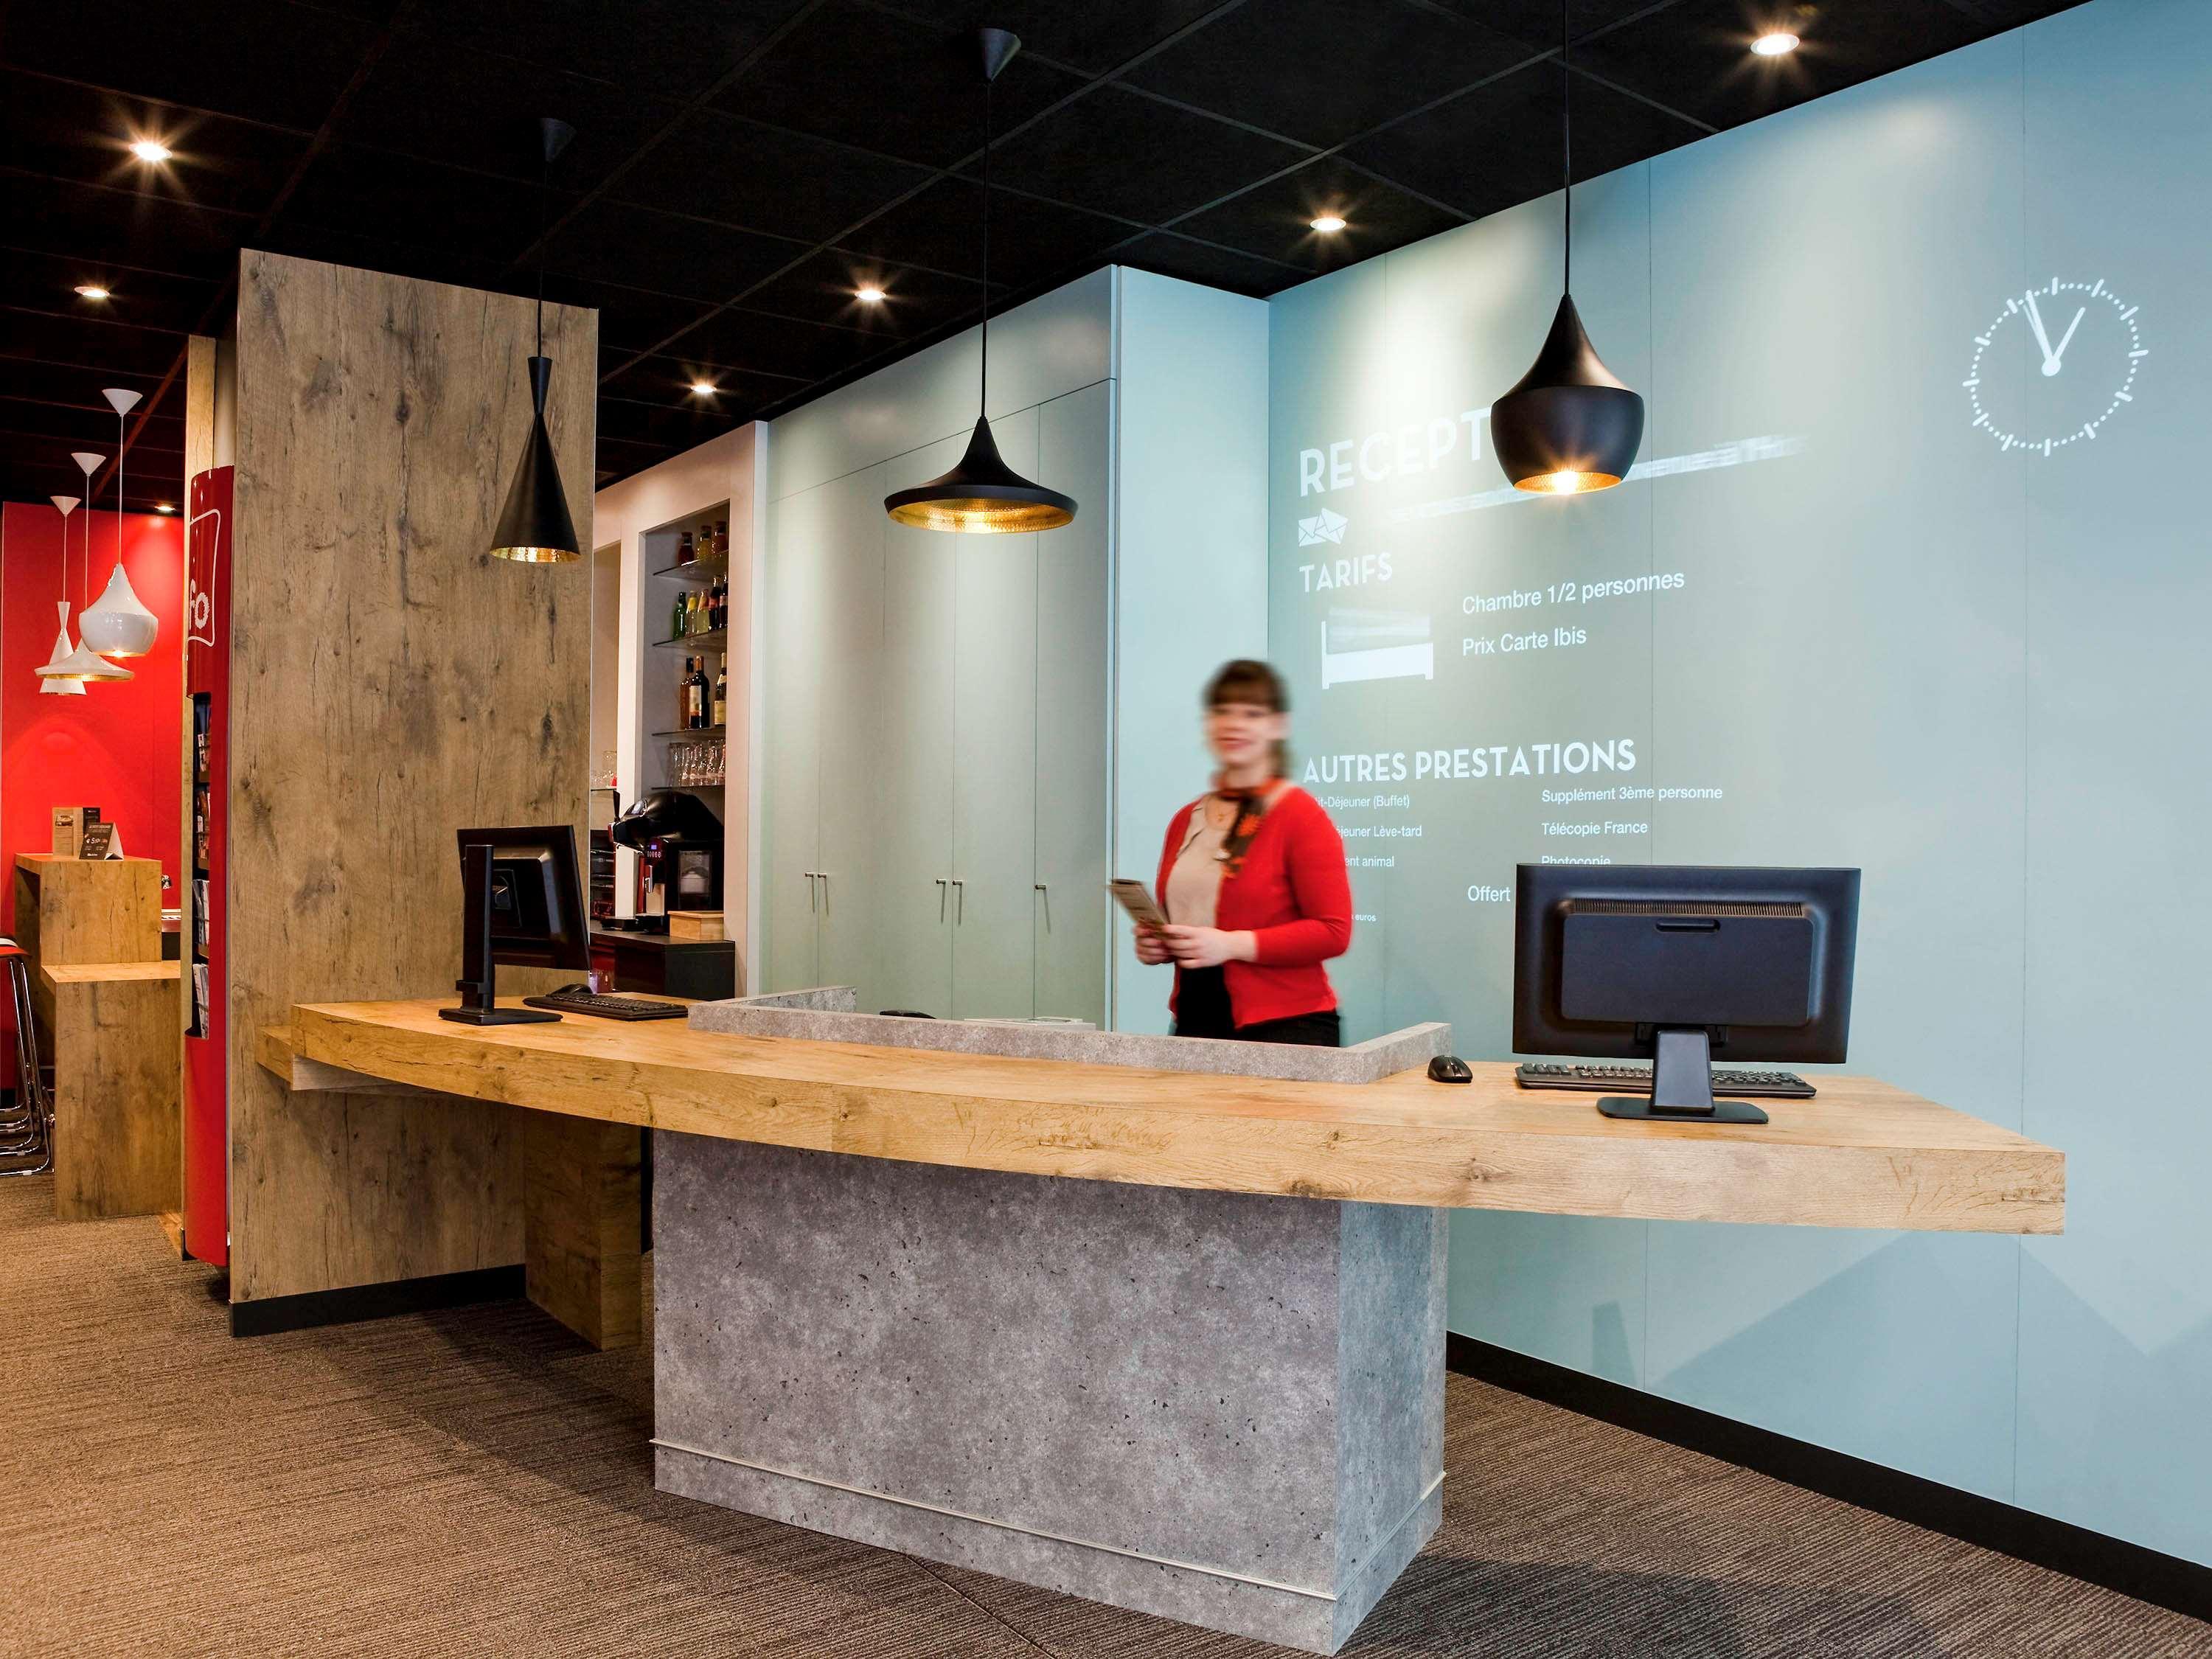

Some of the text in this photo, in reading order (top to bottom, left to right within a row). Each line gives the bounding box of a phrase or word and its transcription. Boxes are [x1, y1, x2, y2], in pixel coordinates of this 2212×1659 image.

[1299, 406, 1491, 496] RECEPT
[1299, 552, 1392, 593] TARIFS
[1462, 571, 1686, 614] Chambre 1/2 personnes
[1462, 626, 1587, 656] Prix Carte Ibis
[1303, 739, 1636, 784] AUTRES PRESTATIONS
[1317, 795, 1411, 810] it-Déjeuner (Buffet)
[1541, 786, 1723, 804] Supplément 3ème personne
[1373, 824, 1422, 838] Lève-tard
[1541, 821, 1649, 838] Télécopie France
[1361, 855, 1395, 867] animal
[1541, 854, 1611, 865] Photocopie
[1467, 884, 1512, 902] Offert
[1354, 914, 1377, 922] euros
